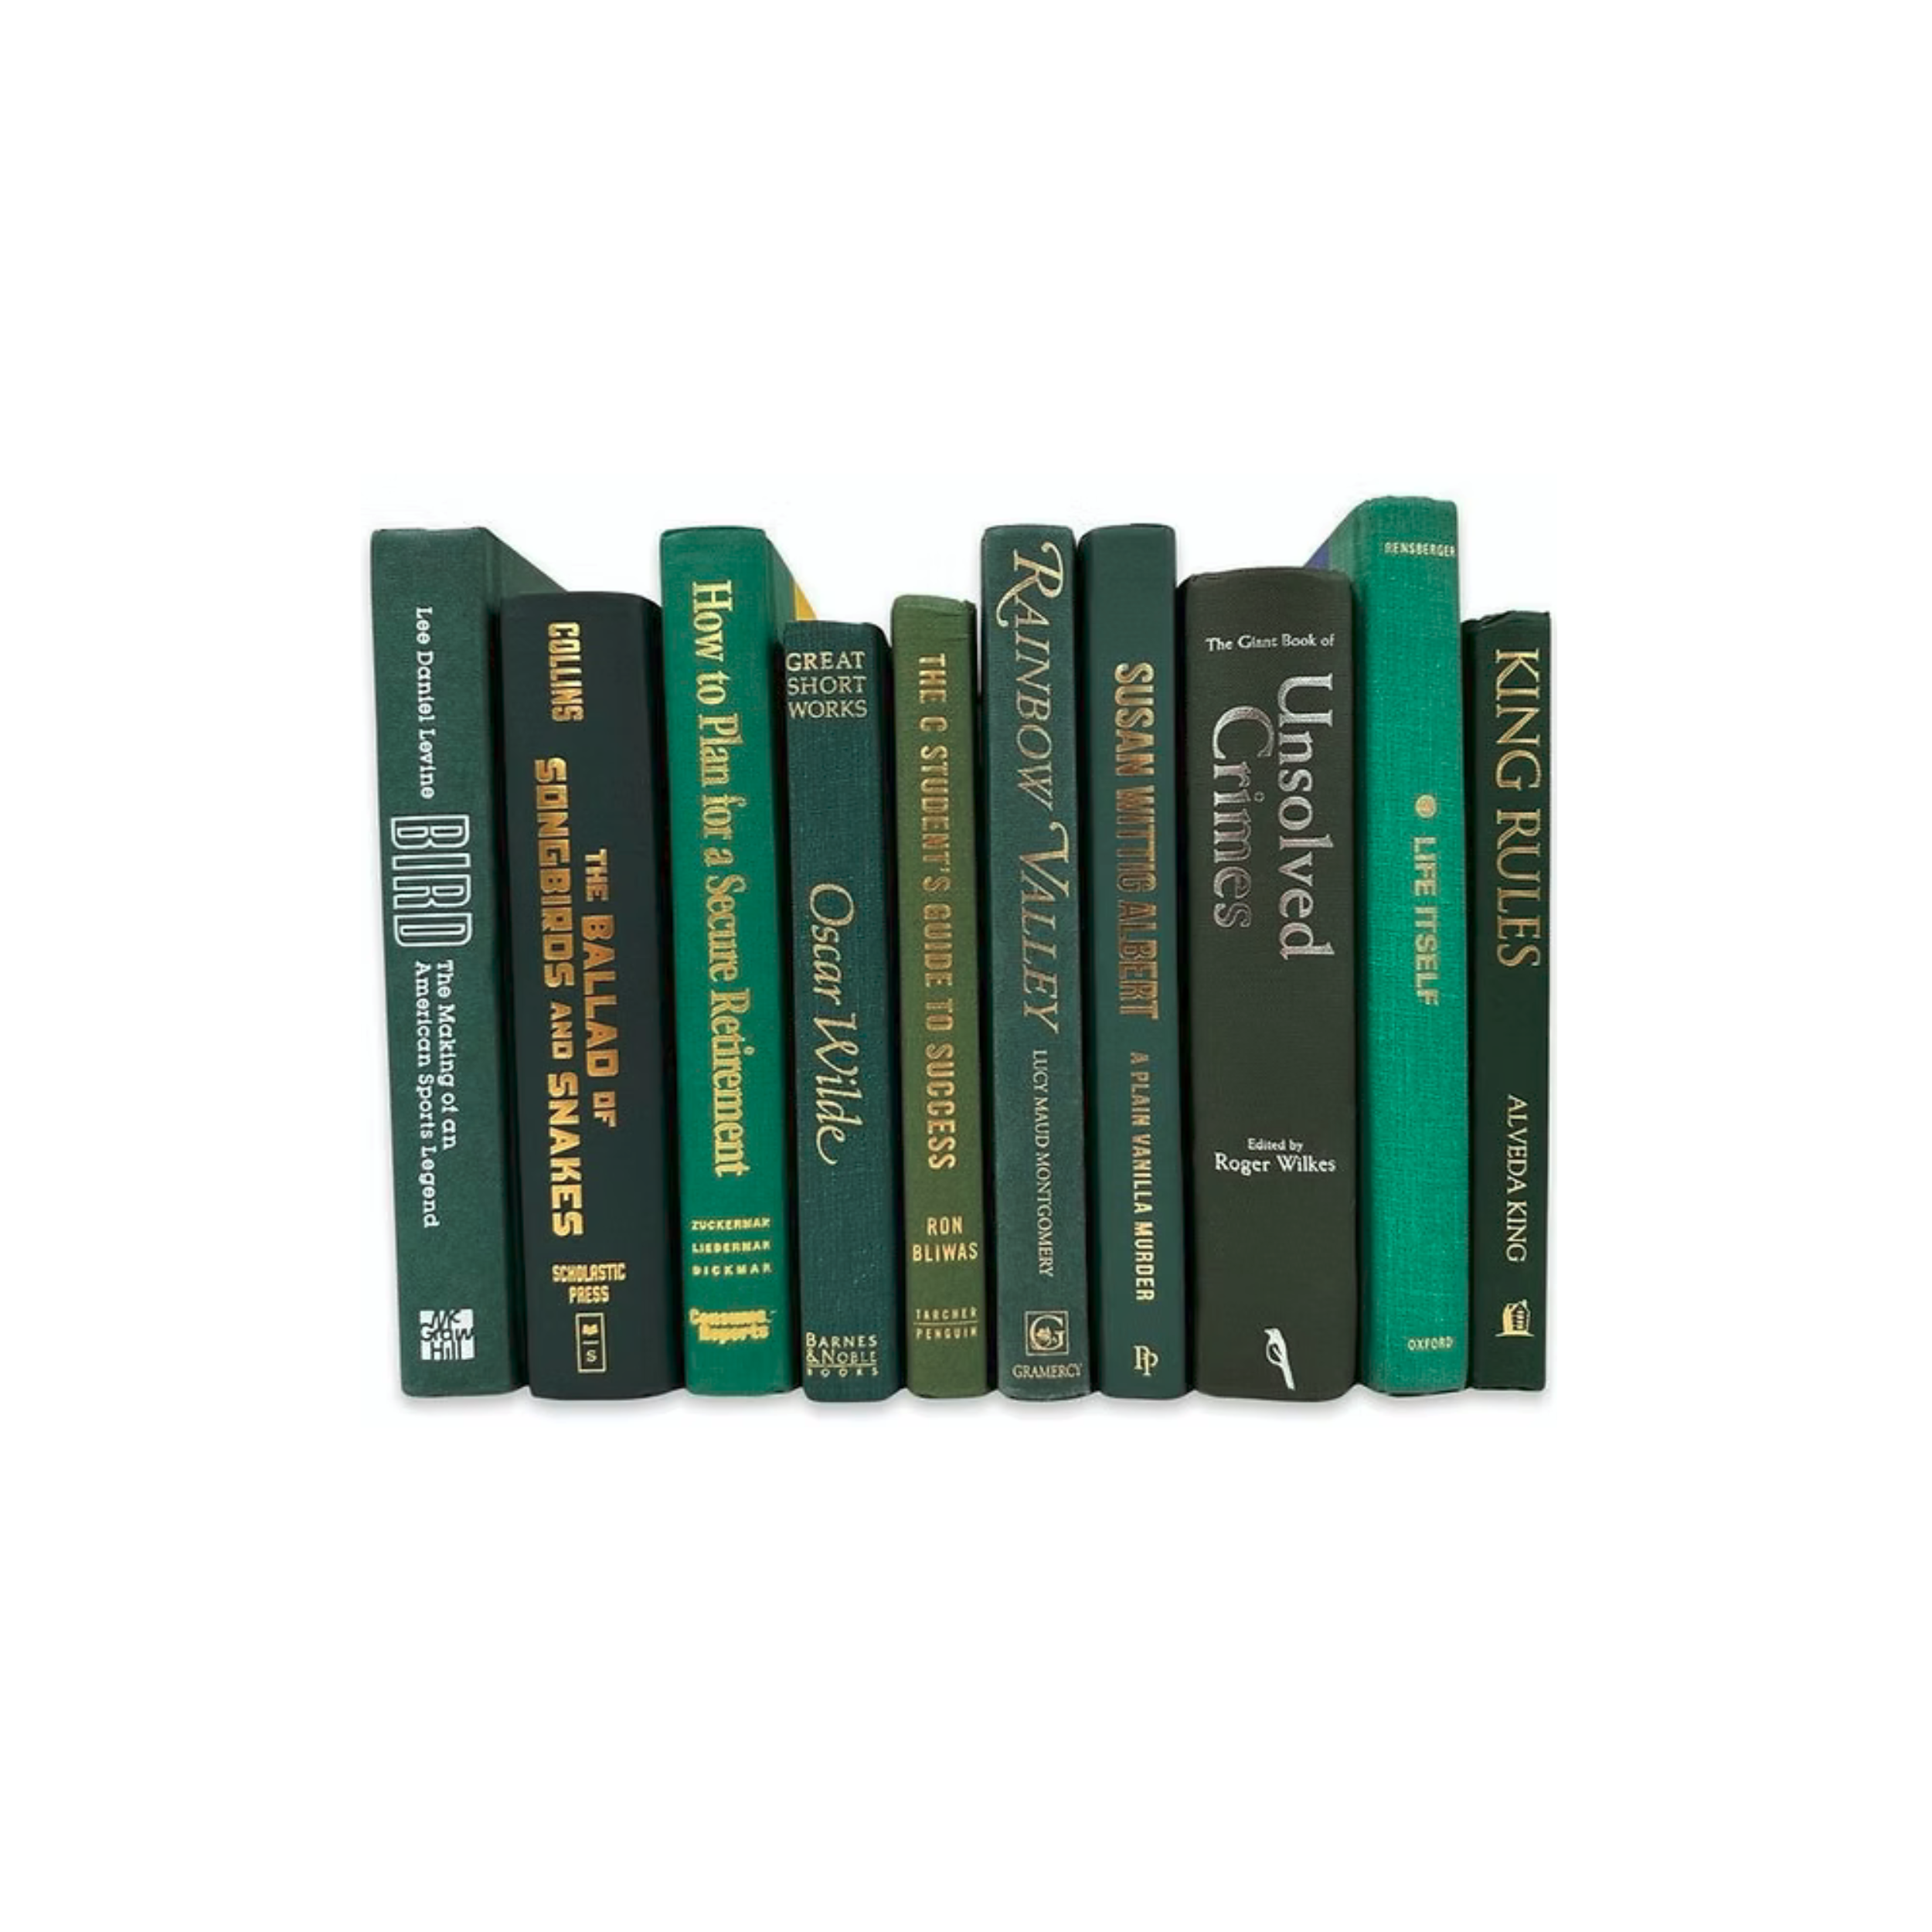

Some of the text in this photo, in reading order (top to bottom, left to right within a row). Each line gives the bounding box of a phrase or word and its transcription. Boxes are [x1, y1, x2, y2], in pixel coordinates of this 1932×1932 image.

[417, 607, 435, 800] Lee Daniel Levine
[547, 621, 583, 723] COLLINS
[785, 651, 866, 672] GREAT
[787, 676, 866, 694] SHORT
[788, 699, 868, 718] WORKS
[1206, 633, 1335, 651] The Giant Book of
[996, 542, 1070, 1033] RAINBOW VALLEY
[1114, 662, 1159, 1020] SUSAN WITTIG ALBERT
[1212, 705, 1275, 927] Crimes
[1277, 673, 1335, 960] Unsolved
[1495, 648, 1542, 967] KING RULES
[390, 814, 473, 947] BIRD
[692, 580, 754, 1178] How to Plan for a Secure Retirement
[919, 653, 957, 1168] THE C STUDENT'S GUIDE TO SUCCESS
[1413, 837, 1440, 1005] LIFE ITSELF
[437, 960, 459, 1150] The Making of an
[535, 757, 583, 1236] SONGBIRDS AND SNAKES
[581, 849, 618, 1128] THE BALLAD OF
[809, 883, 862, 1166] Oscar Wilde
[414, 961, 440, 1229] American Sports Legend
[1247, 1138, 1304, 1153] Edited by
[927, 1216, 963, 1236] RON
[1032, 1049, 1054, 1278] LUCY MAUD MONTGOMERY
[1129, 1051, 1155, 1302] A PLAIN VANILLA MURDER
[1213, 1152, 1336, 1175] Roger Wilkes
[1506, 1094, 1528, 1264] ALVEDA KING
[552, 1263, 627, 1282] SCHOLASTIC
[570, 1285, 609, 1304] PRESS
[913, 1242, 978, 1262] BLIWAS
[916, 1307, 978, 1320] TARCHER
[586, 1349, 597, 1362] S
[806, 1366, 879, 1377] BOOKS
[917, 1325, 978, 1340] PENGUIN
[1012, 1363, 1082, 1379] GRAMERCY
[1407, 1336, 1453, 1350] OXFORD
